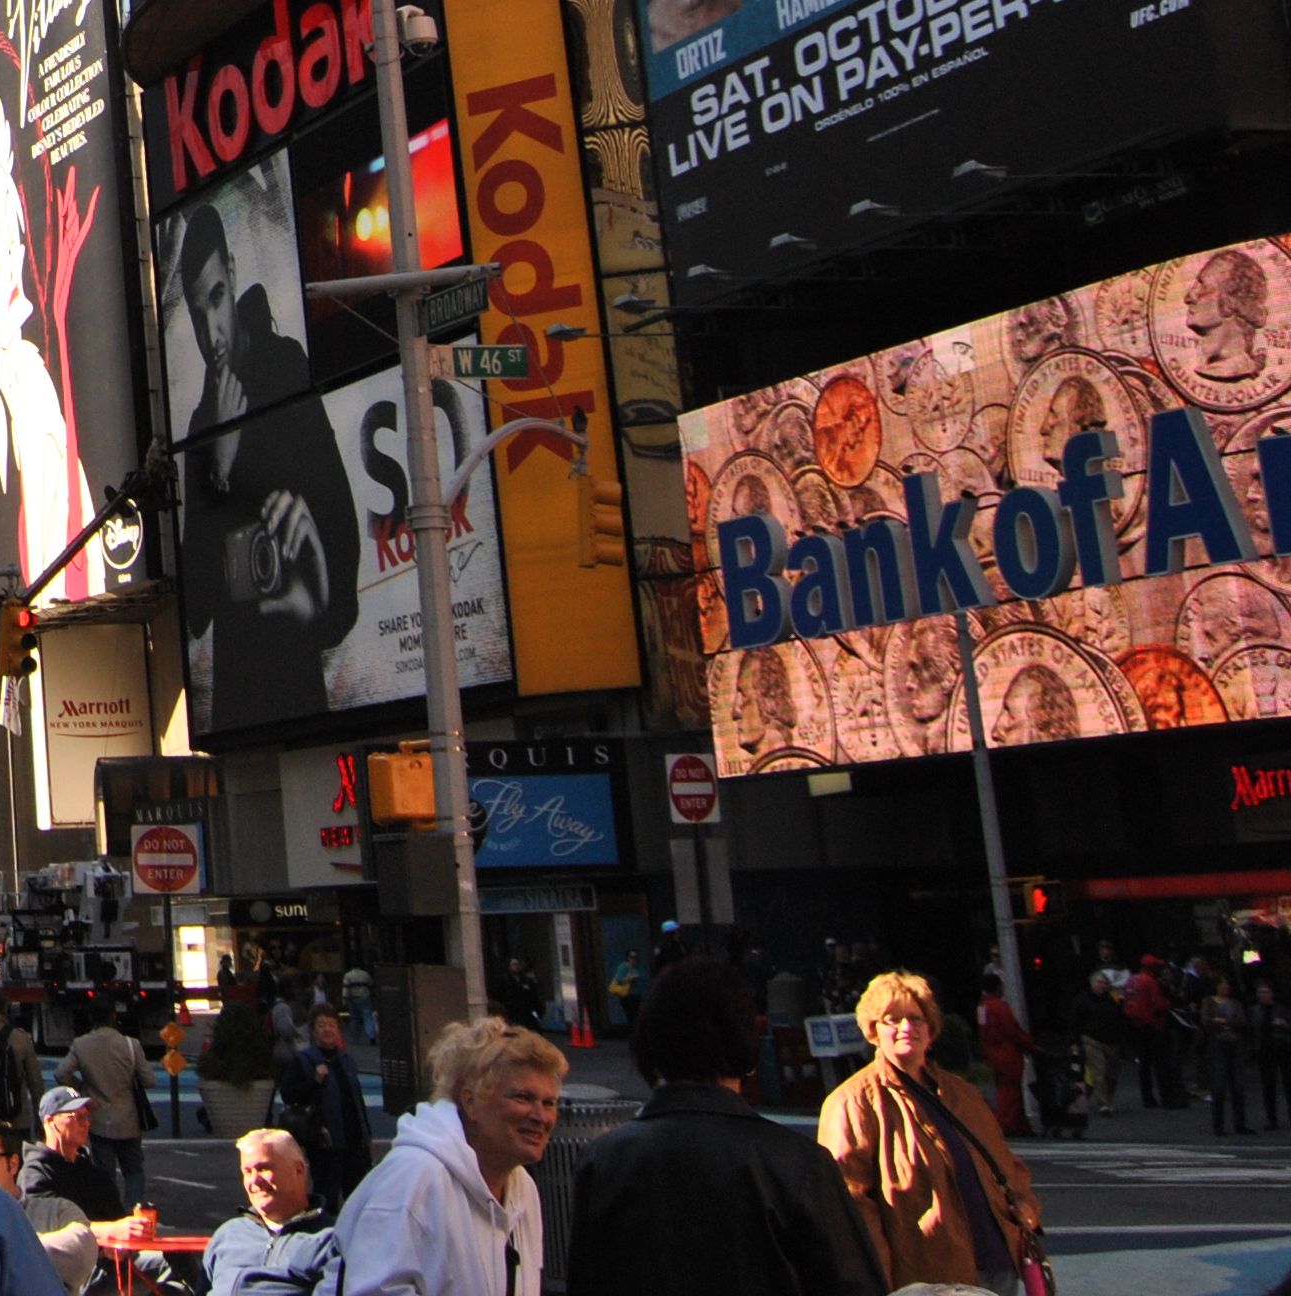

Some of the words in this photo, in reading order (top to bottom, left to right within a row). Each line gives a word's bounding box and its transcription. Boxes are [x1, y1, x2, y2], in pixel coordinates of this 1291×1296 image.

[674, 28, 727, 81] ORTIZ
[690, 57, 780, 128] SAT.
[667, 112, 751, 179] LIVE
[760, 77, 826, 150] ON
[466, 73, 596, 475] Kodak
[429, 283, 487, 325] BROADWAY
[457, 349, 475, 374] W
[479, 348, 502, 375] 46
[507, 349, 523, 363] ST
[719, 470, 996, 650] Bank
[993, 429, 1124, 602] of
[377, 615, 408, 637] SHARE
[57, 699, 132, 719] Marriott
[72, 721, 98, 729] YORK
[100, 720, 144, 730] MARQUIS
[135, 803, 204, 823] MARQUIS
[469, 779, 528, 834] Fly
[525, 795, 605, 857] Away
[143, 840, 158, 850] DO
[162, 839, 186, 850] NOT
[147, 869, 184, 880] ENTER
